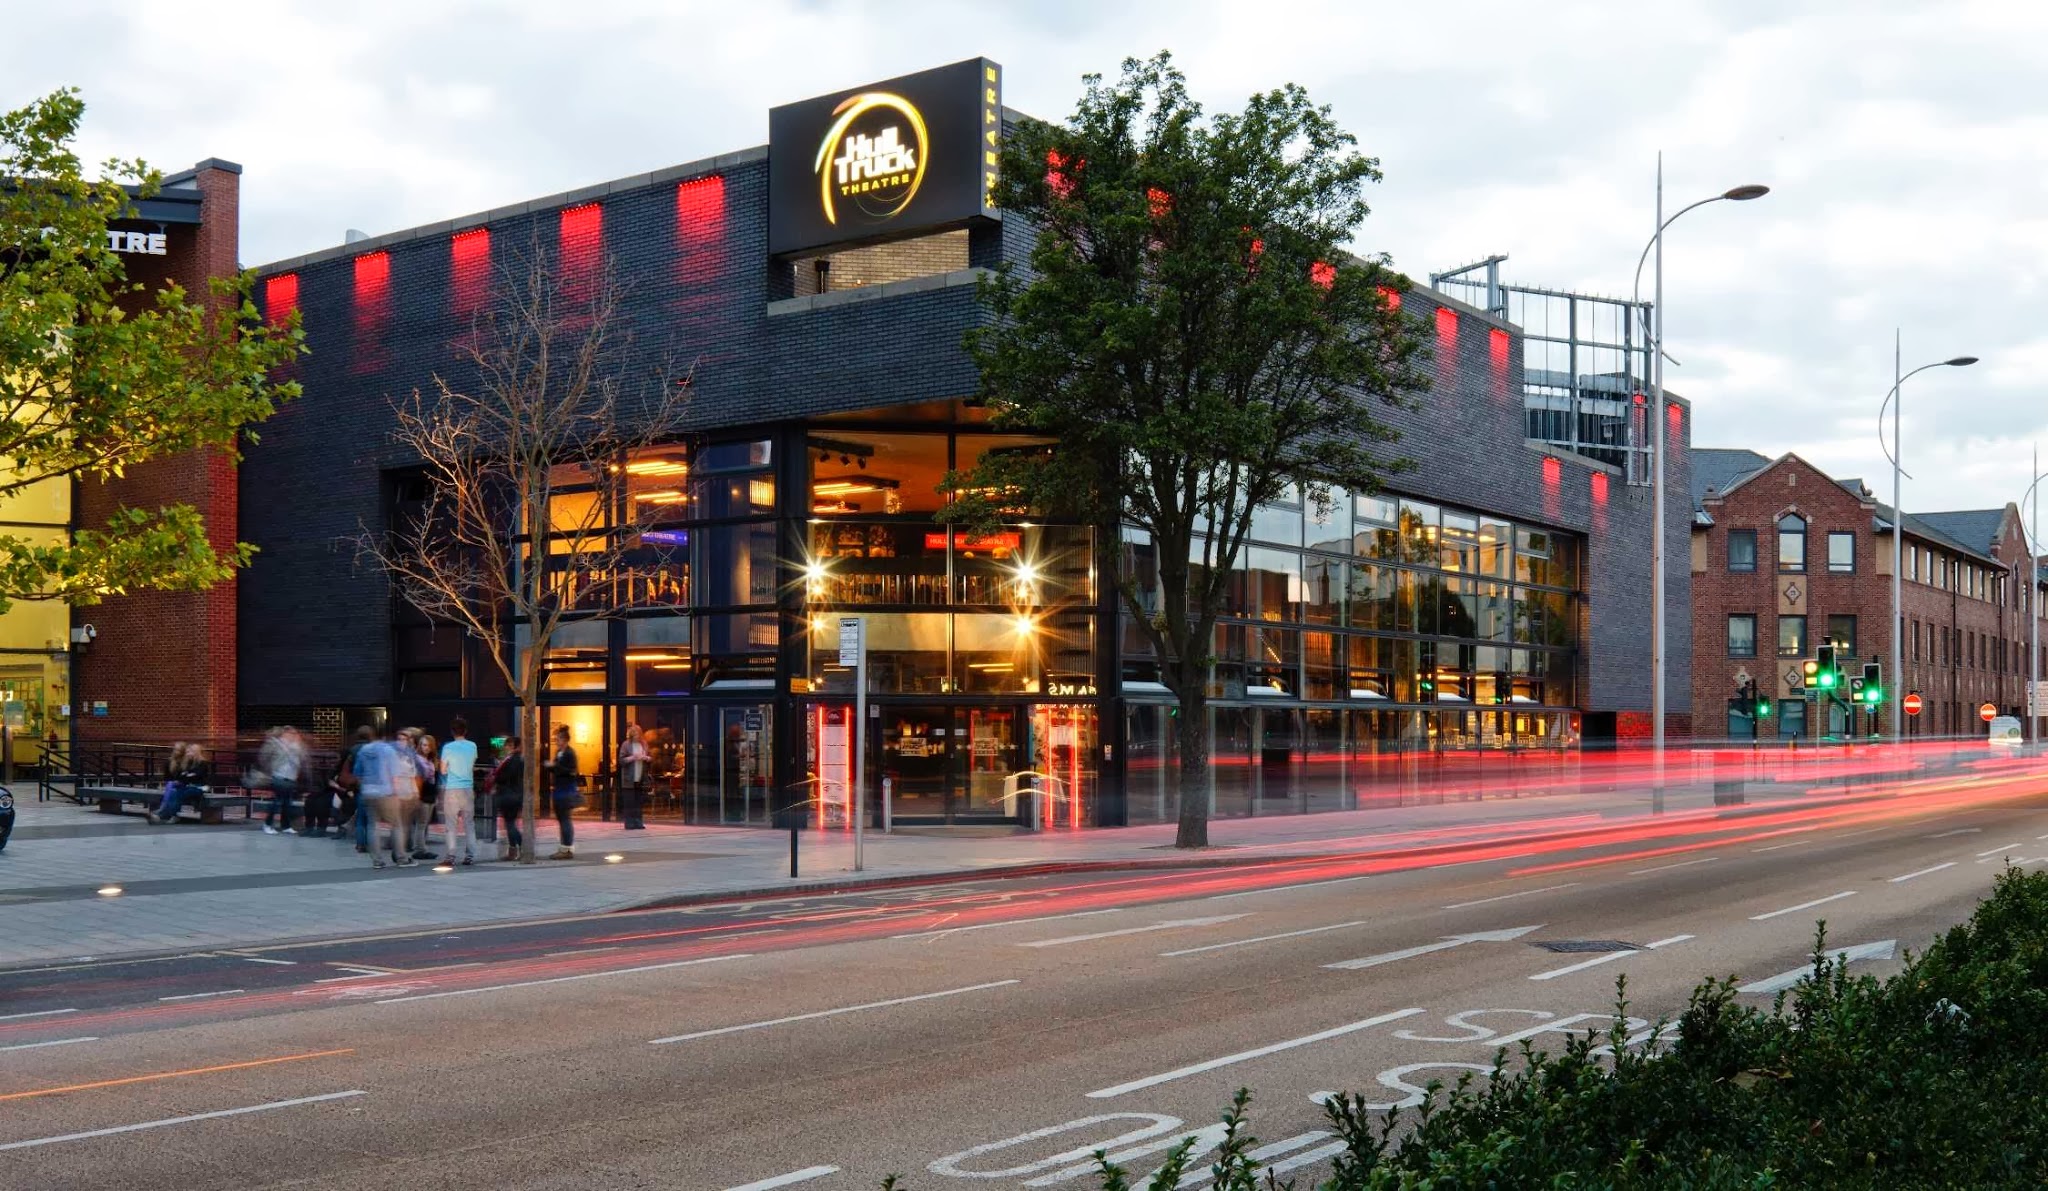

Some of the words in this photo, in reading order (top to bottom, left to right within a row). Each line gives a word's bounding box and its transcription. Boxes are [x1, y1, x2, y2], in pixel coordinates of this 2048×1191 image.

[845, 126, 898, 161] Hull
[986, 67, 996, 208] THEATRE
[834, 144, 916, 184] Truck
[841, 174, 909, 195] THEATRE
